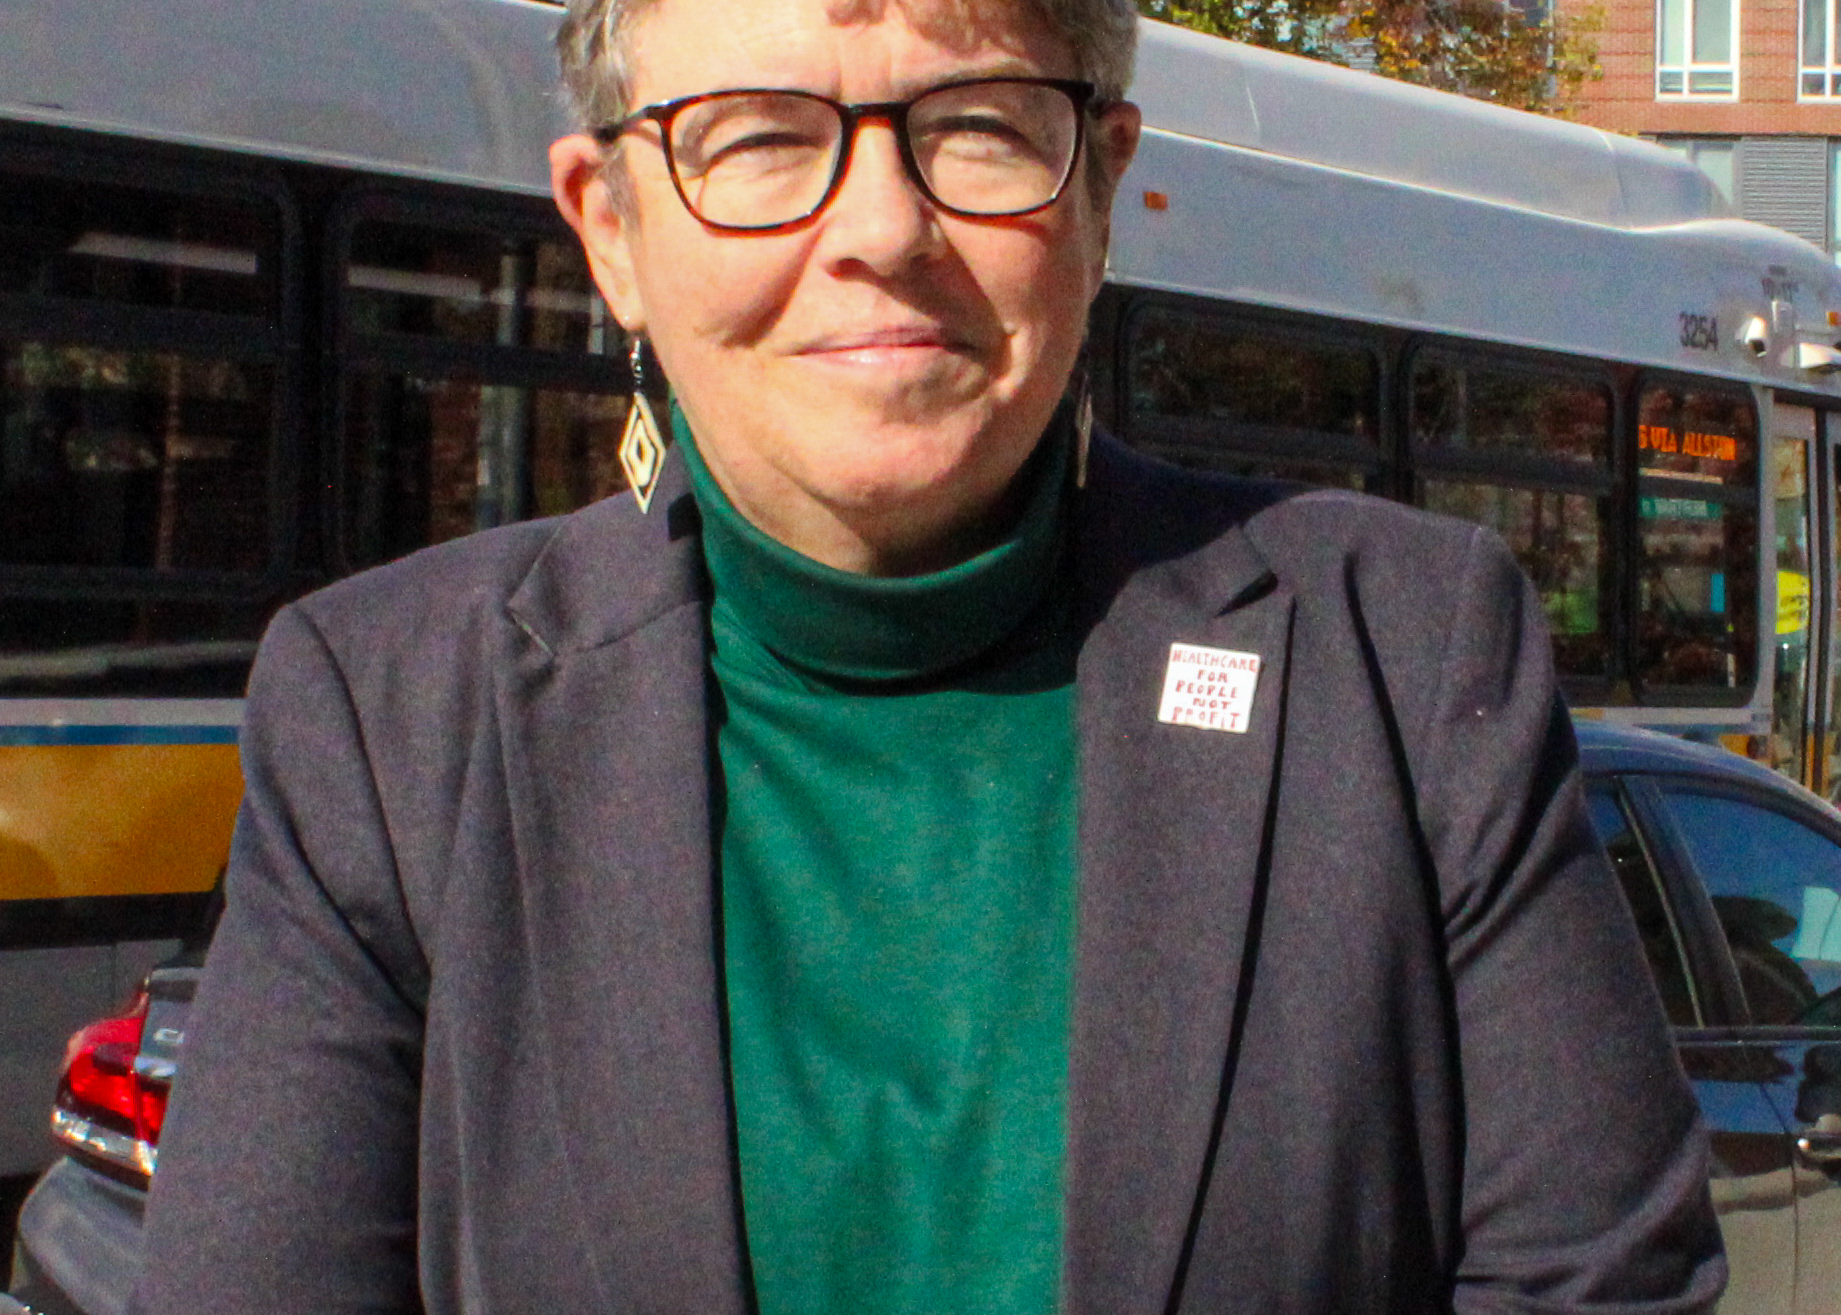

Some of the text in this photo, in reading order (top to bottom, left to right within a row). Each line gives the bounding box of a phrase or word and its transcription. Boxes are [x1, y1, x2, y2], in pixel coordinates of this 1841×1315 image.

[1679, 311, 1719, 351] 3254
[1172, 650, 1258, 672] HEALTHCARE
[1197, 669, 1227, 683] FOR
[1175, 680, 1238, 698] PEOPLE
[1193, 697, 1231, 710] NOT
[1171, 706, 1241, 729] PROFIT
